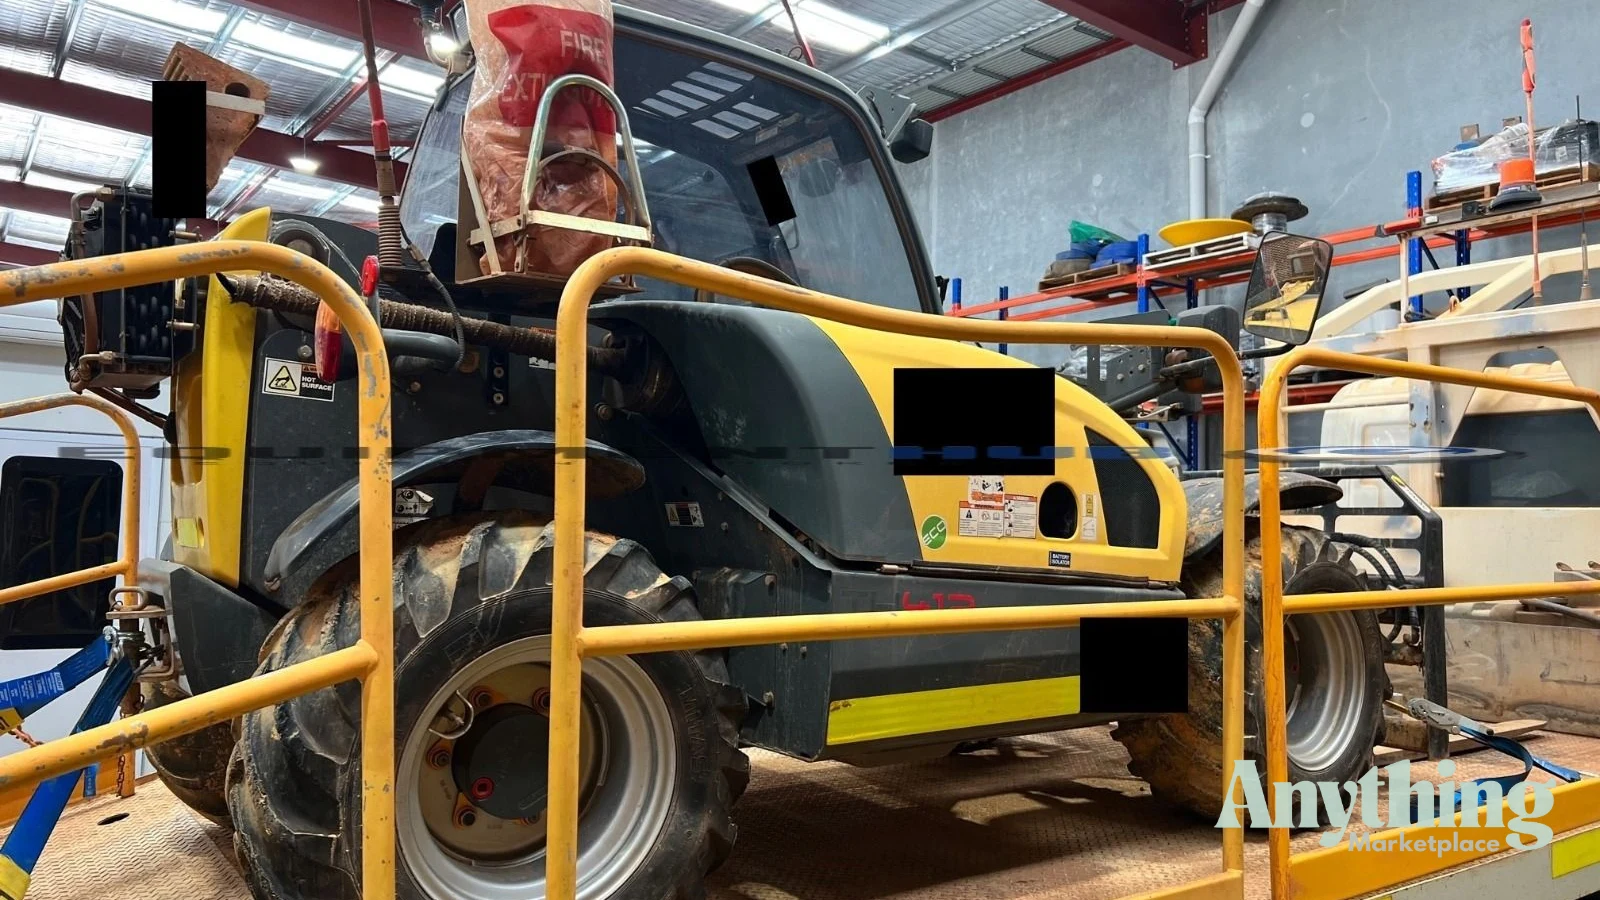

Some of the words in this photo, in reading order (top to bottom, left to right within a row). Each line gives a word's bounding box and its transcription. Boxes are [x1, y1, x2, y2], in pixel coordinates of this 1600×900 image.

[560, 30, 607, 64] FIRE
[301, 375, 317, 383] HOT
[301, 382, 333, 391] SURFACE
[922, 519, 947, 546] ECO
